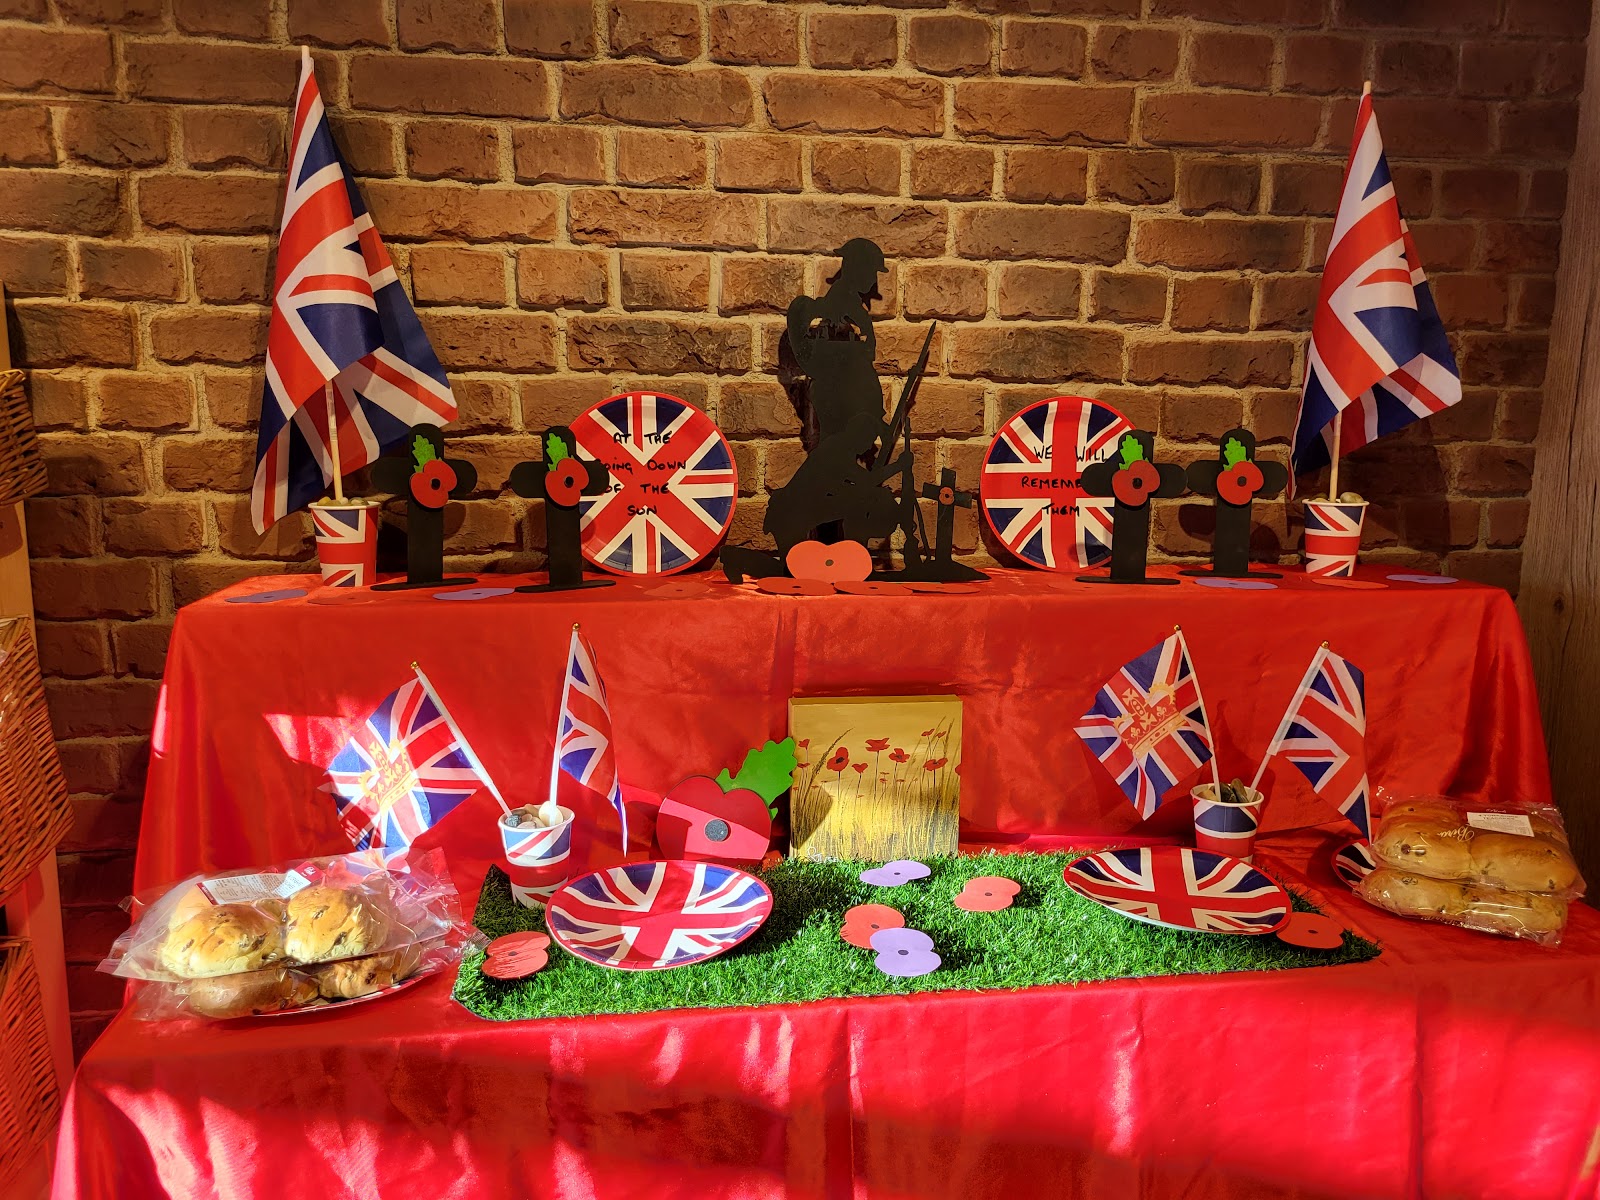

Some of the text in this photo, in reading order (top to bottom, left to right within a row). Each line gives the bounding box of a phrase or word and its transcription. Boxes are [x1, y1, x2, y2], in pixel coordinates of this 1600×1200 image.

[613, 431, 673, 444] AT THE
[1034, 445, 1108, 462] WE WILL
[597, 458, 687, 475] OING DOWN
[640, 482, 669, 494] THE
[1021, 475, 1082, 489] REMEMB
[1041, 502, 1080, 517] THEM
